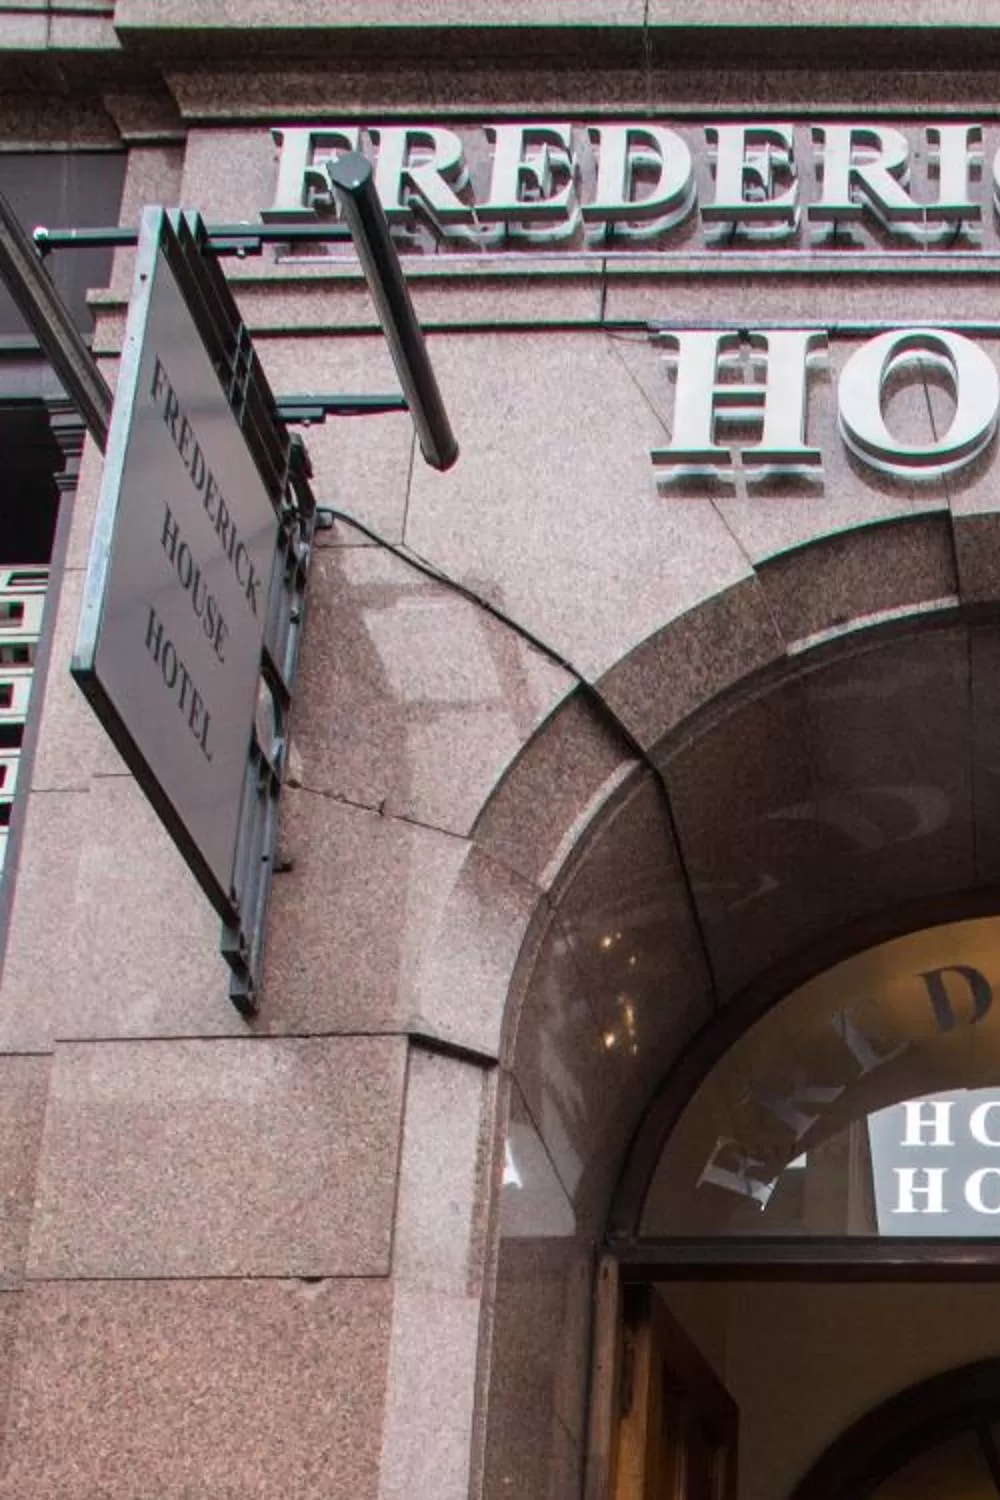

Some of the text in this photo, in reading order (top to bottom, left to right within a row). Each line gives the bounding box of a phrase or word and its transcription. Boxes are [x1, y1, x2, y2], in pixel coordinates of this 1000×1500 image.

[149, 352, 263, 616] FREDERICK
[160, 502, 230, 664] HOUSE
[144, 606, 213, 762] HOTEL
